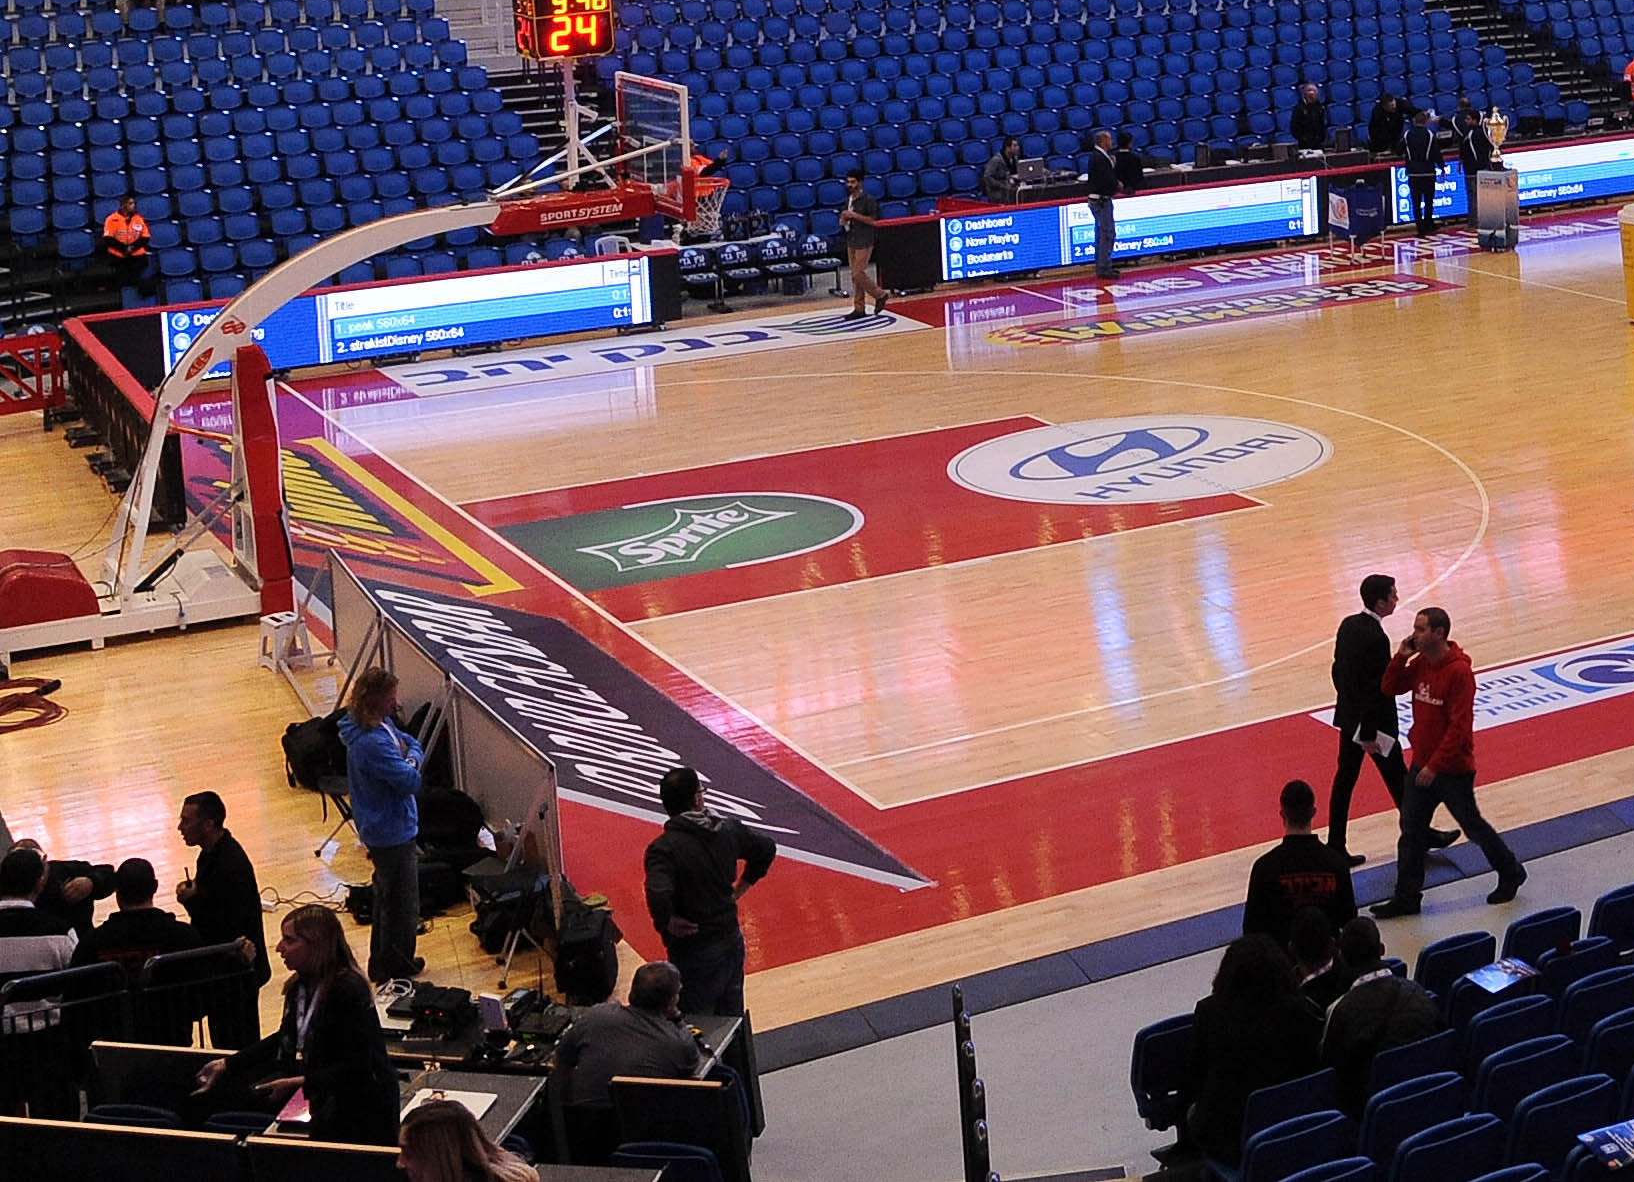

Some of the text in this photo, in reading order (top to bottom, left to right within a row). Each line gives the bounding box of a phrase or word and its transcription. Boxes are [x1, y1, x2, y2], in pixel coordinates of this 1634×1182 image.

[551, 15, 597, 52] 24
[965, 216, 1013, 232] Dashboard
[966, 232, 1020, 248] Now Playing
[967, 250, 1014, 266] Bookmarks
[1324, 279, 1432, 303] 2015
[333, 299, 355, 313] Title
[1038, 294, 1335, 341] Winner
[376, 313, 415, 329] 560x64
[425, 326, 464, 344] 560x64
[403, 330, 780, 387] בנק יהב
[1074, 433, 1302, 500] HYUNDAI
[617, 507, 749, 566] Sprite
[1473, 691, 1569, 717] מתחילי
